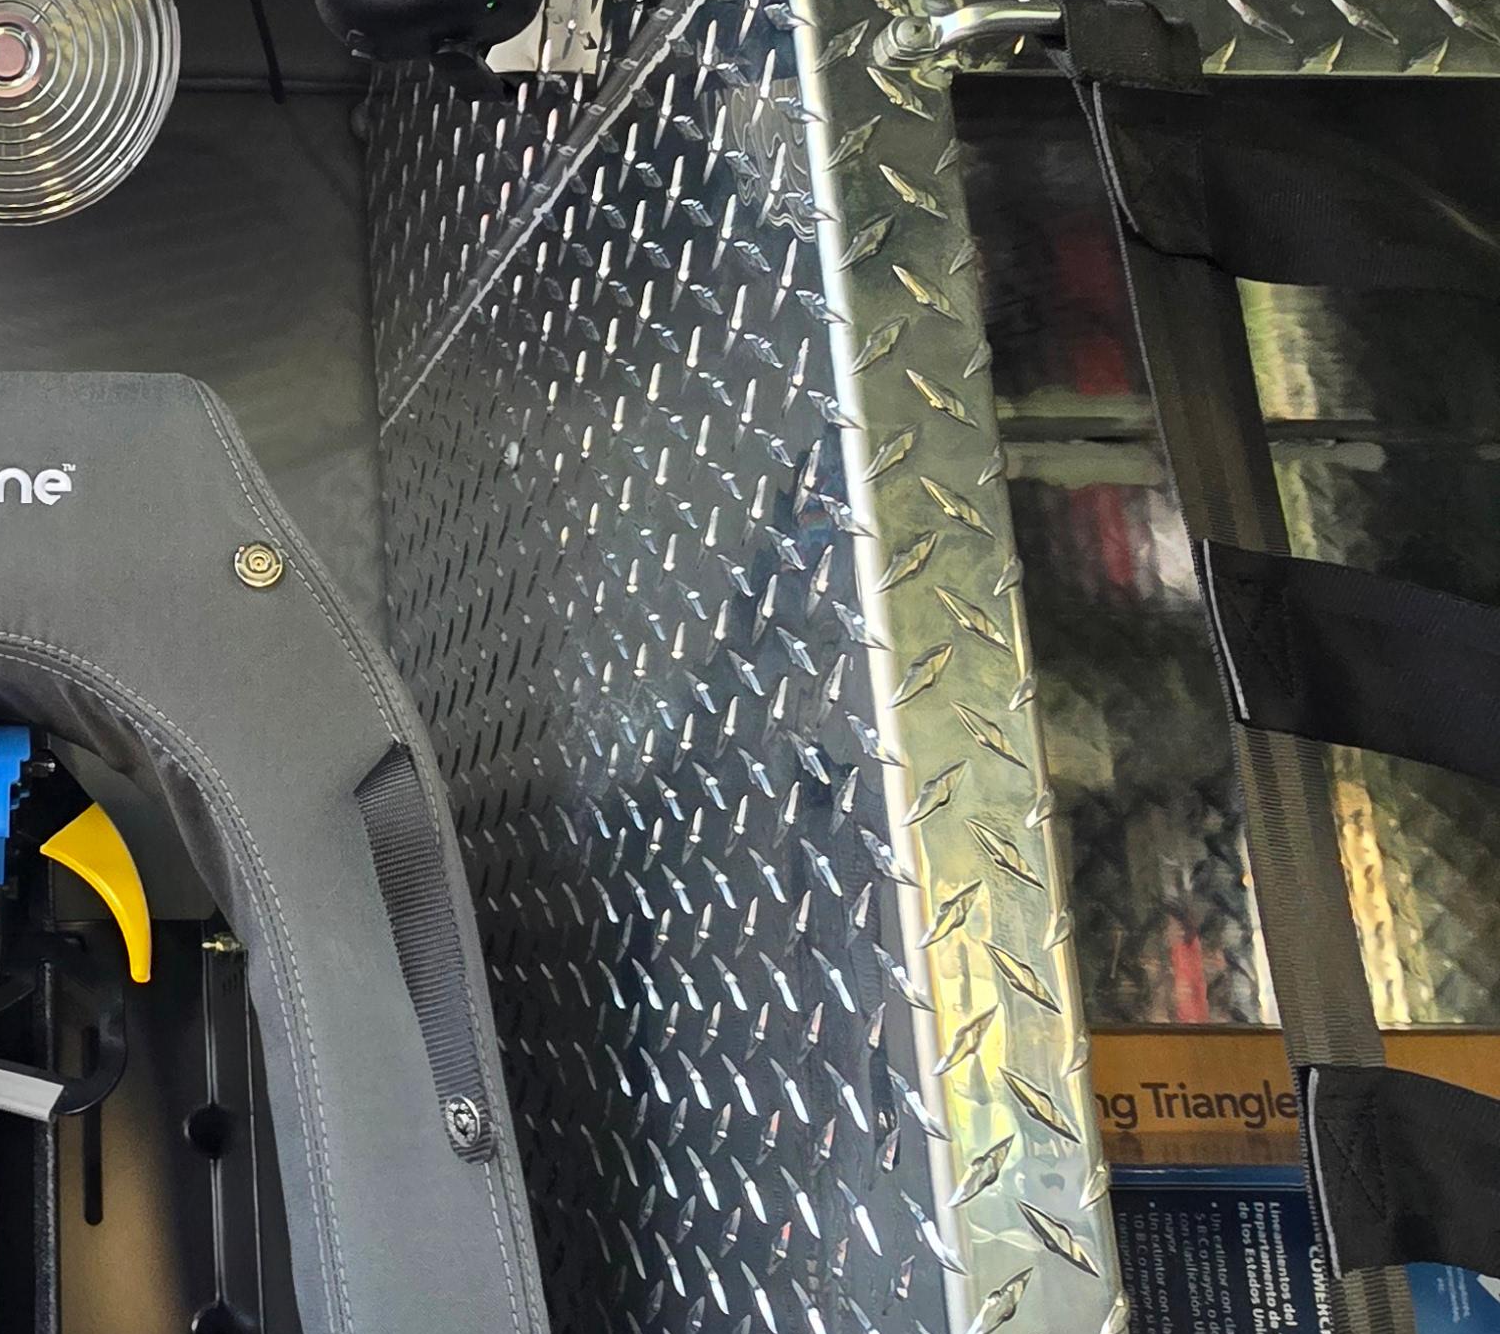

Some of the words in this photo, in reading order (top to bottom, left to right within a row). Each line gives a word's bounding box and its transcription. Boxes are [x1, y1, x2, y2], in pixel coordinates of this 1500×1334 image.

[1149, 1212, 1160, 1230] Un
[1211, 1213, 1221, 1231] Un
[1238, 1202, 1249, 1219] de
[1180, 1212, 1190, 1236] con
[1242, 1224, 1252, 1244] los
[1151, 1235, 1166, 1286] extintor
[1213, 1235, 1228, 1287] extintor
[1254, 1202, 1277, 1307] Departamento
[1268, 1310, 1281, 1329] de
[1269, 1202, 1291, 1299] Lineamientos
[1283, 1303, 1298, 1326] del
[1245, 1248, 1260, 1304] Estados
[1140, 1270, 1153, 1310] mayor
[1159, 1290, 1169, 1312] con
[1221, 1290, 1231, 1313] con
[1208, 1310, 1216, 1318] o
